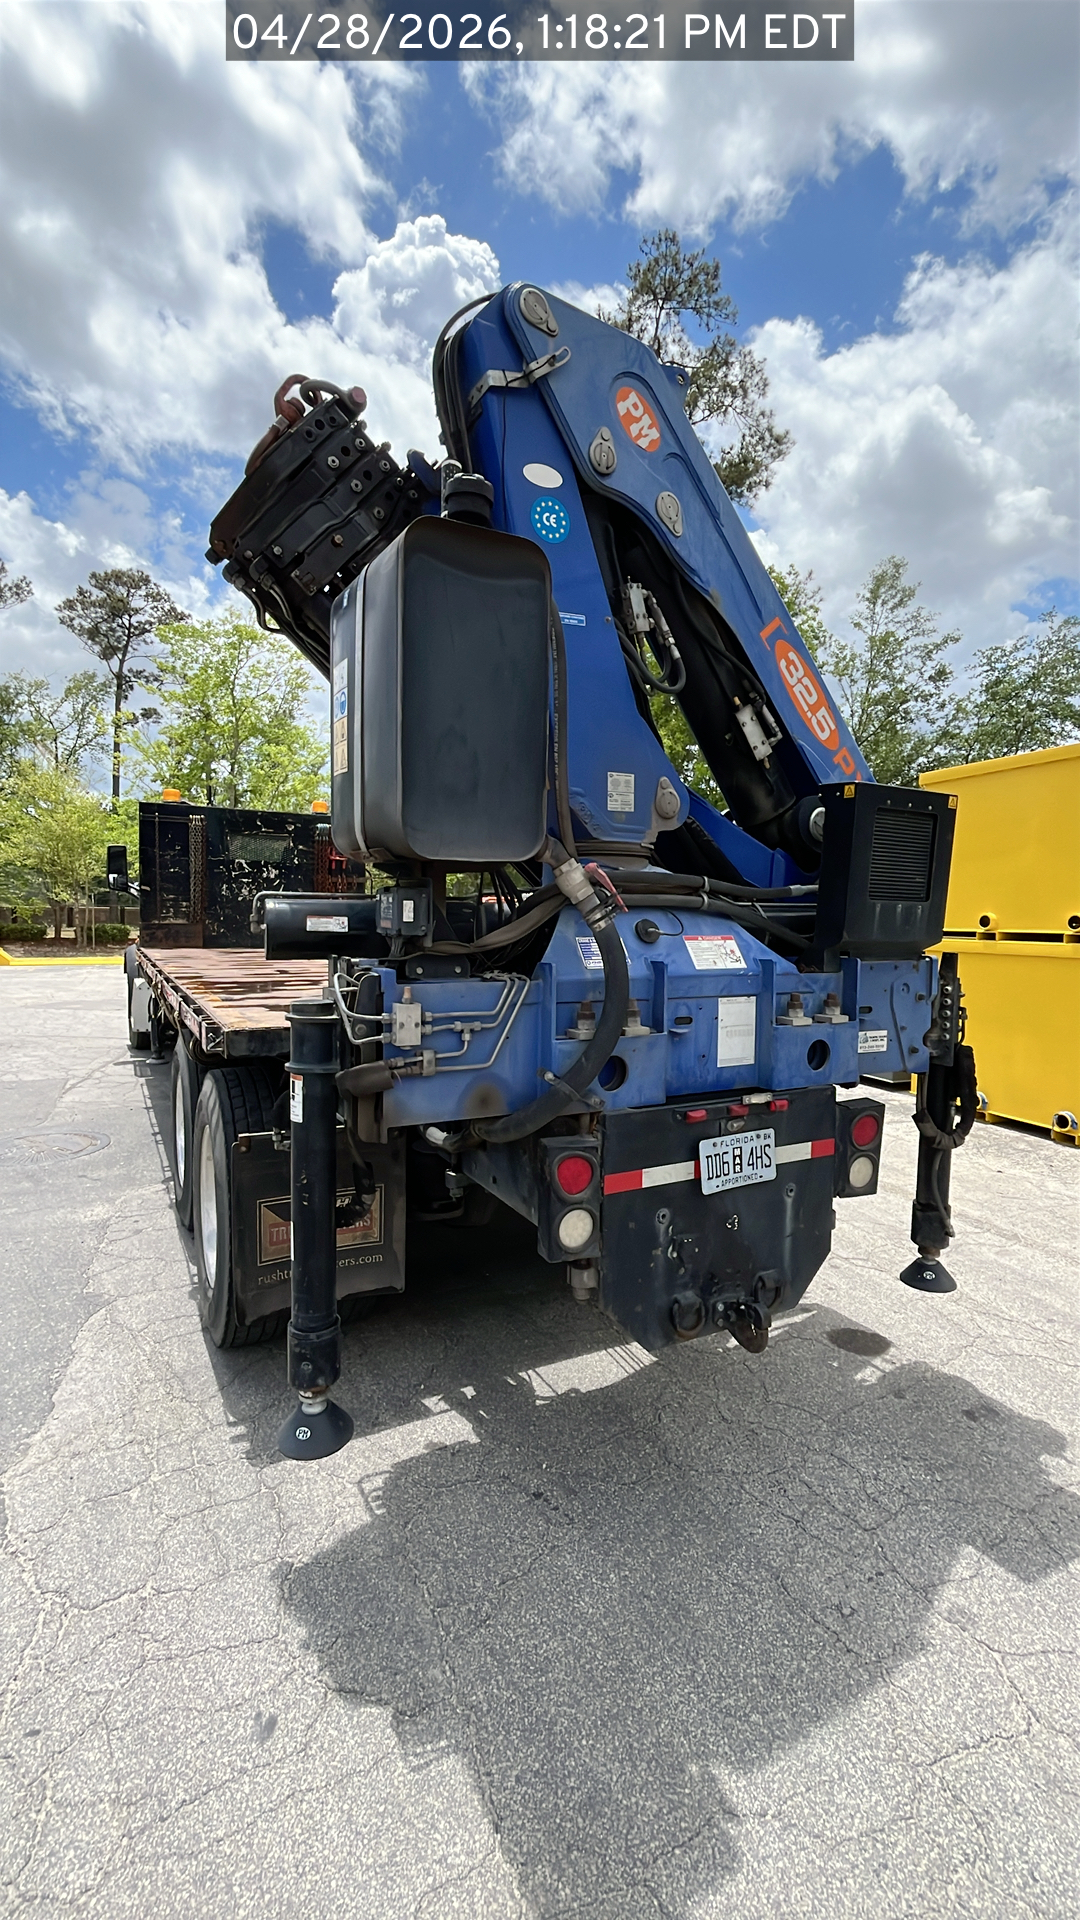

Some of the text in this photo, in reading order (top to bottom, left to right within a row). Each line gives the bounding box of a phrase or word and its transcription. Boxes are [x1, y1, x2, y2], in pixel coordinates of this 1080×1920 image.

[617, 391, 660, 449] PM
[543, 512, 557, 528] CE
[780, 651, 863, 782] 32.5 P
[720, 1135, 754, 1148] FLORIDA
[705, 1144, 772, 1181] DD6 4HS
[721, 1173, 758, 1187] APPORTIONED
[297, 1428, 309, 1438] PM
